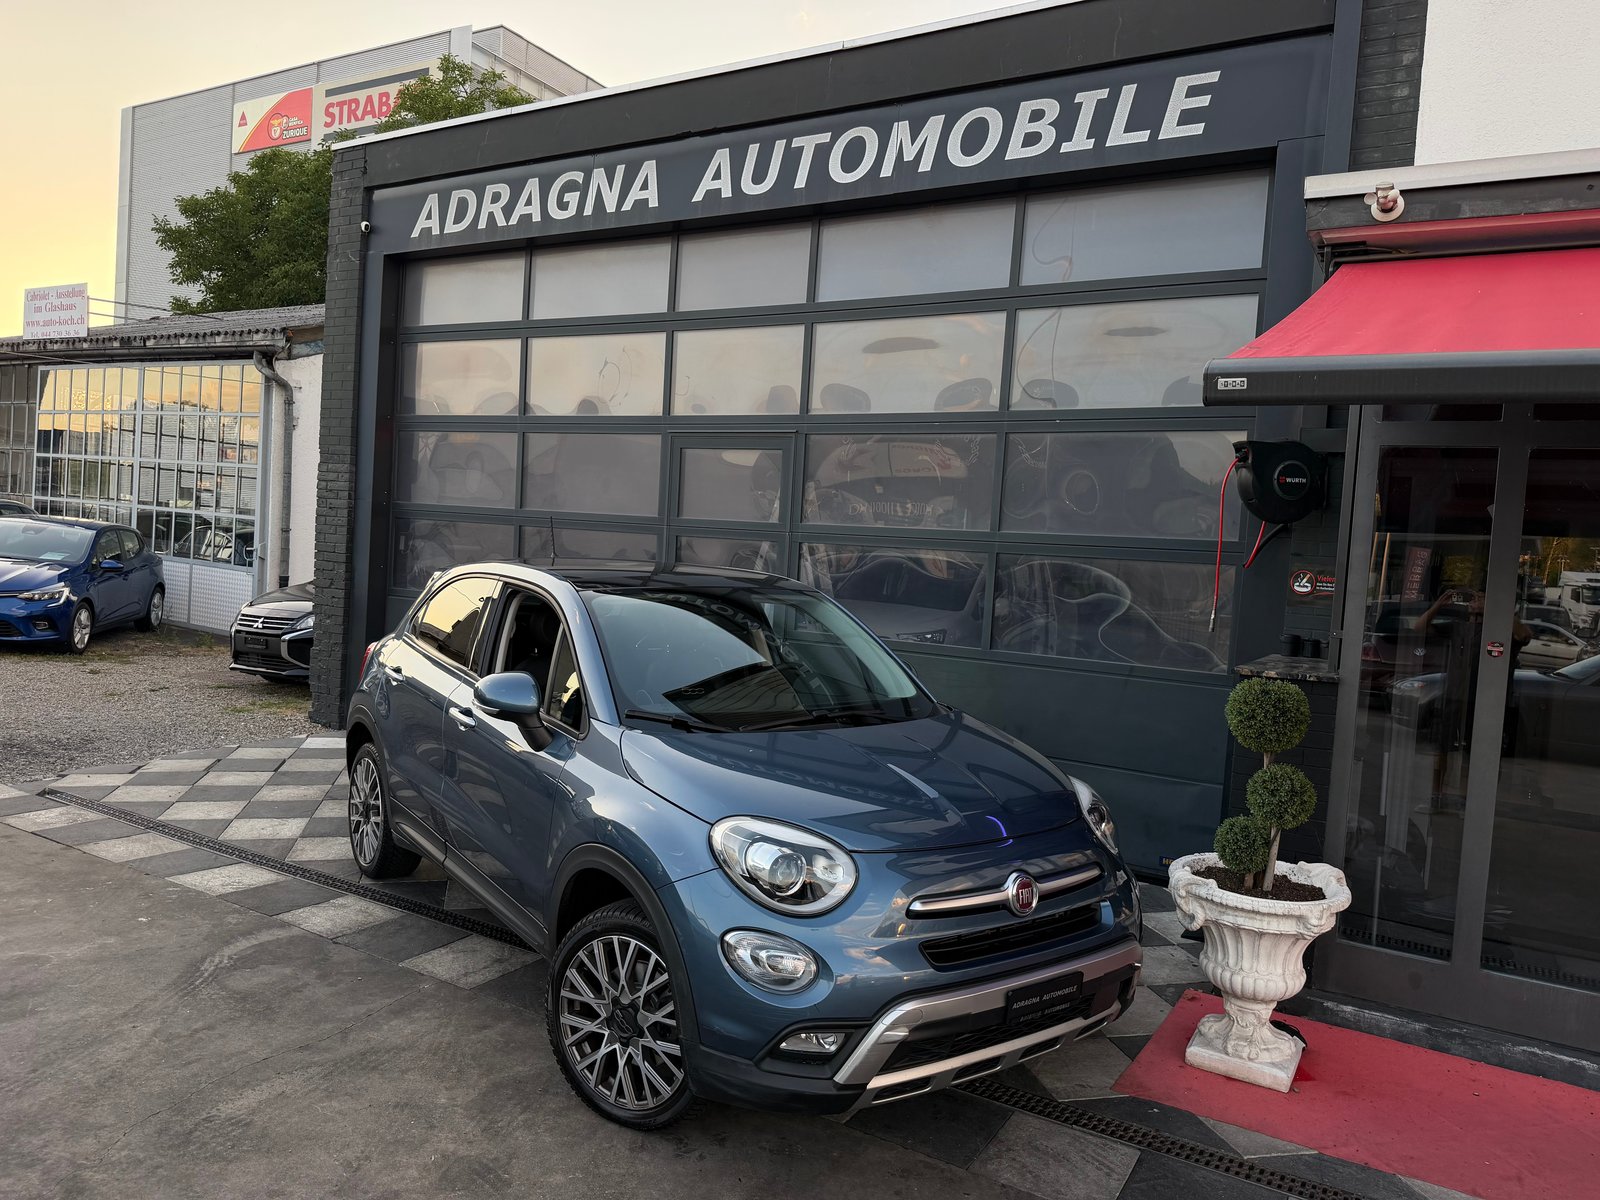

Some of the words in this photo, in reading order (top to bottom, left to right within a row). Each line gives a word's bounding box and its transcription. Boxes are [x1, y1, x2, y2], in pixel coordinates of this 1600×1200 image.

[282, 126, 308, 139] ZURIQUE
[411, 160, 659, 239] ADRAGNA
[691, 71, 1221, 202] AUTOMOBILE
[27, 291, 49, 302] Cabriolet
[55, 288, 85, 300] Ausstellung
[34, 303, 42, 313] im
[45, 301, 76, 312] Glashaus
[26, 314, 85, 327] www.auto-koch.ch
[1019, 888, 1033, 905] FIAT
[1012, 997, 1040, 1009] ADRAGNA
[1042, 985, 1077, 1000] AUTOMOBILE
